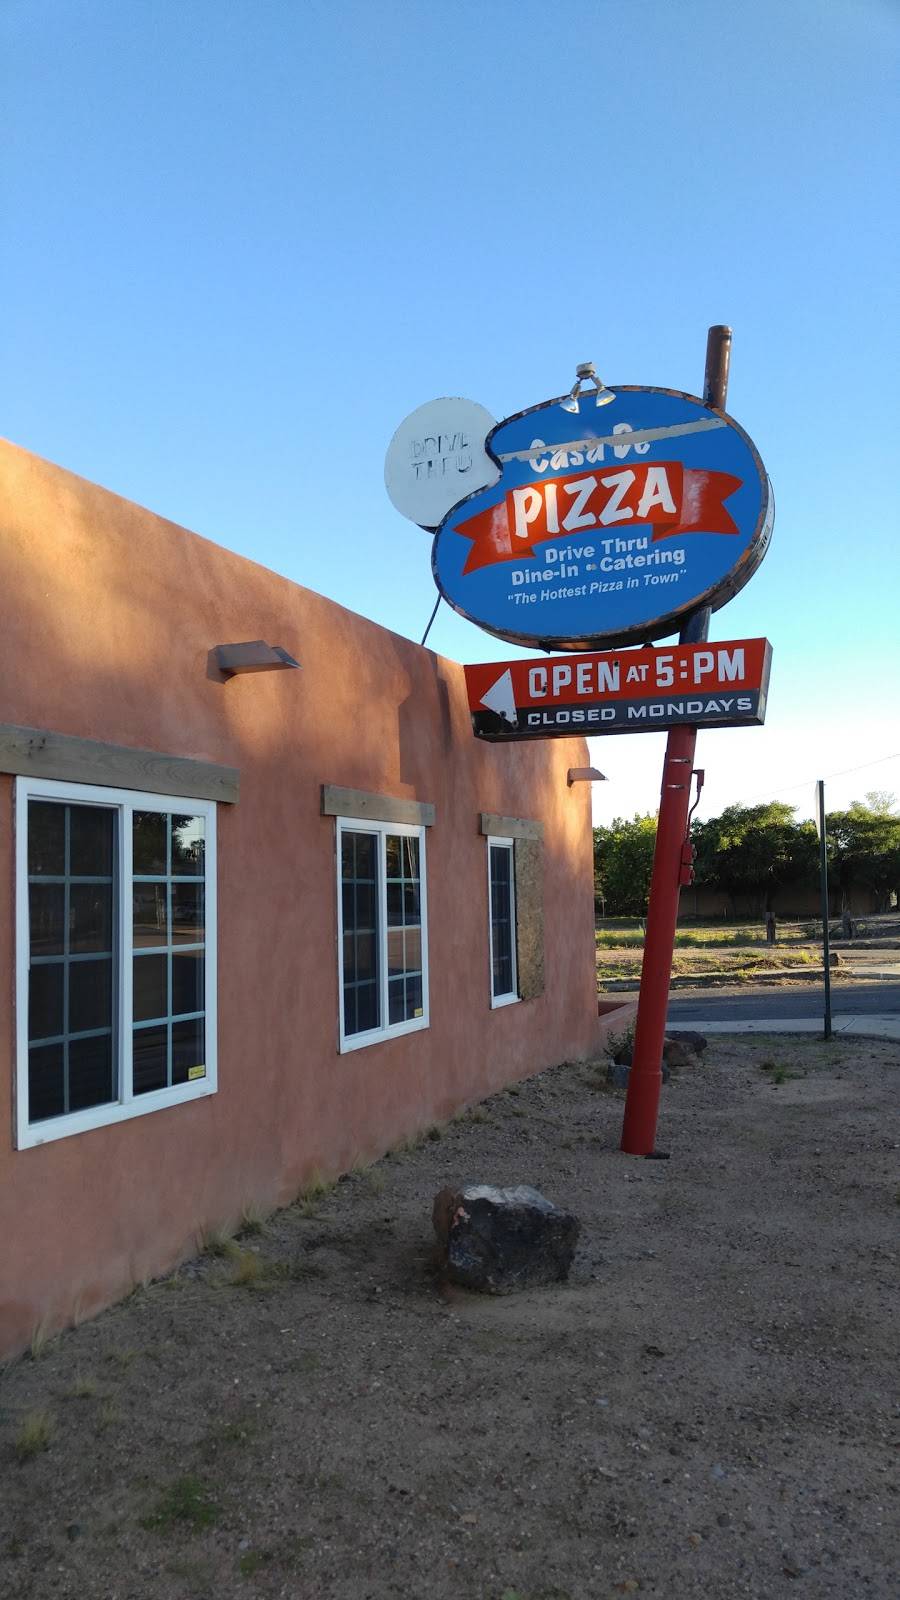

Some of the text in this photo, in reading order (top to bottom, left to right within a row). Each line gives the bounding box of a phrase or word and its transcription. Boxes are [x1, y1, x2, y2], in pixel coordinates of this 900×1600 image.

[529, 438, 605, 473] Casa
[512, 466, 677, 538] PIZZA
[512, 549, 686, 586] Dine-In Catering
[545, 537, 648, 564] Drive Thru
[541, 584, 586, 601] Hottest
[590, 579, 623, 594] Pizza
[627, 577, 639, 588] in
[528, 648, 745, 698] OPEN AT 5:PM
[527, 697, 752, 725] CLOSED MONDAYS
